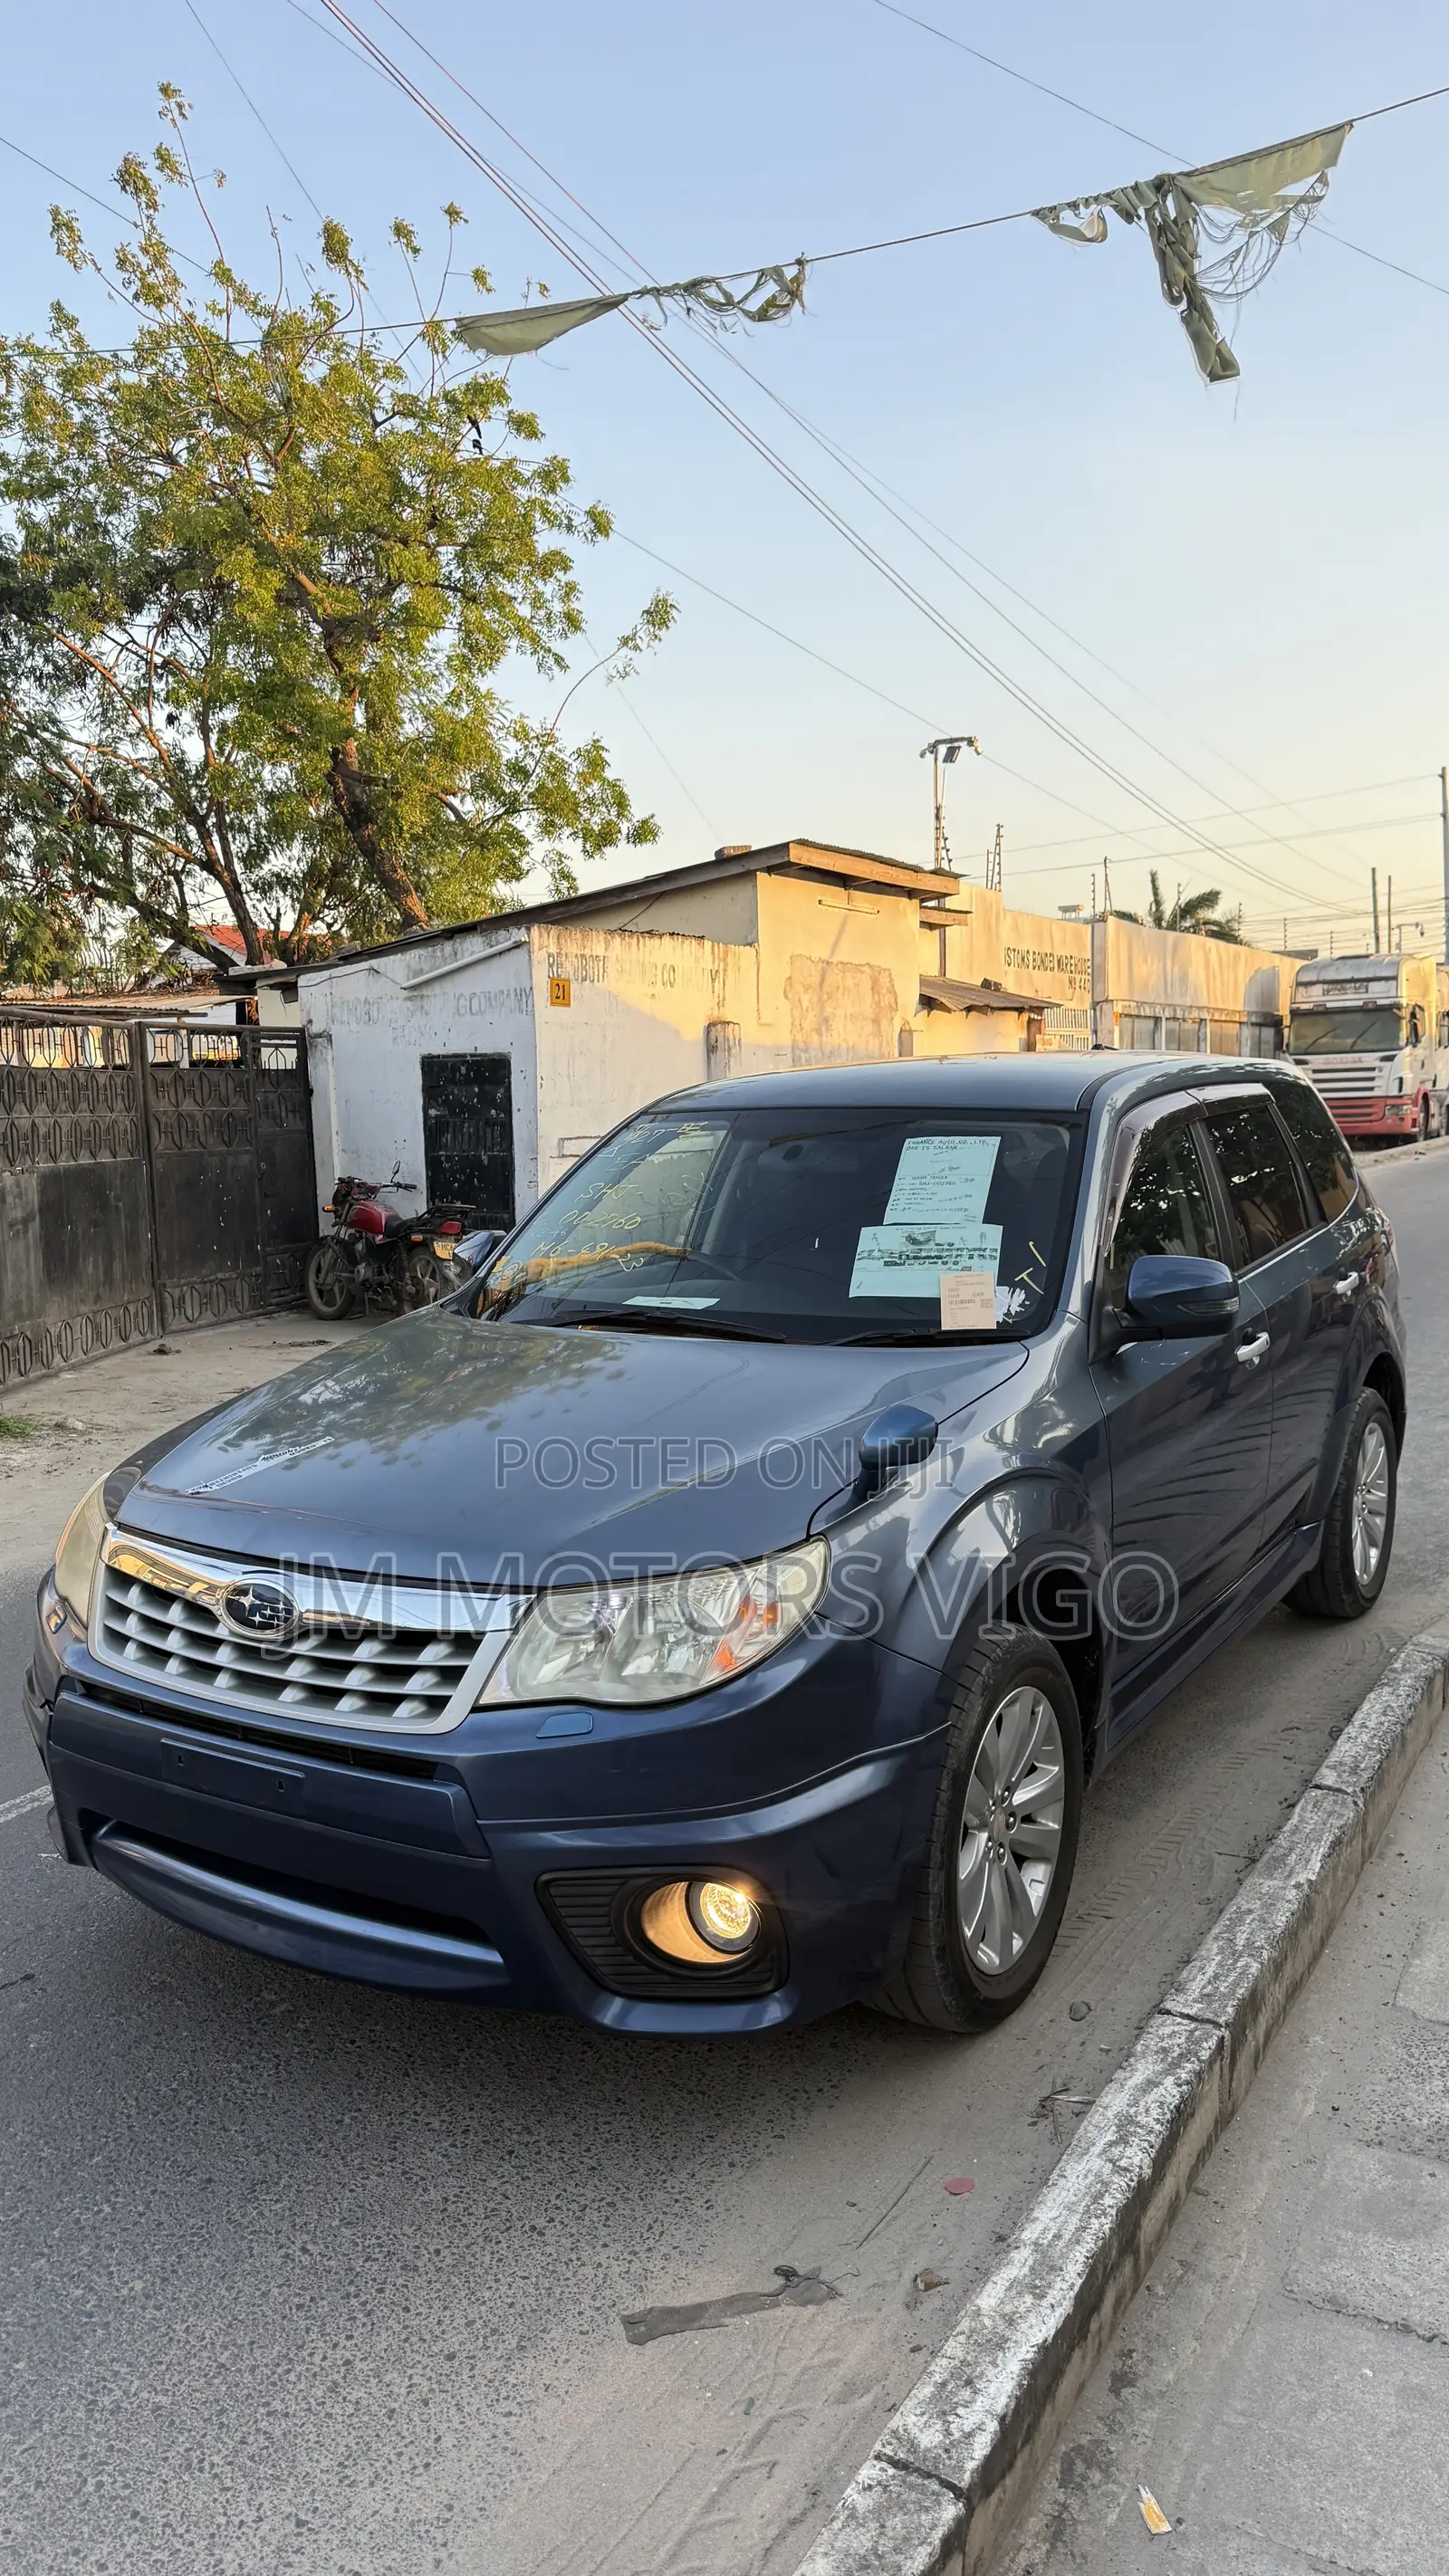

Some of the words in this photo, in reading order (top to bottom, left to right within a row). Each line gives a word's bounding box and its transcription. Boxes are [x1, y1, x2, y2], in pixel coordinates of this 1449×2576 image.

[1032, 951, 1055, 972] BONDED
[1056, 954, 1090, 976] WAREHOUSE
[554, 982, 566, 1001] 21
[1079, 979, 1090, 993] 440
